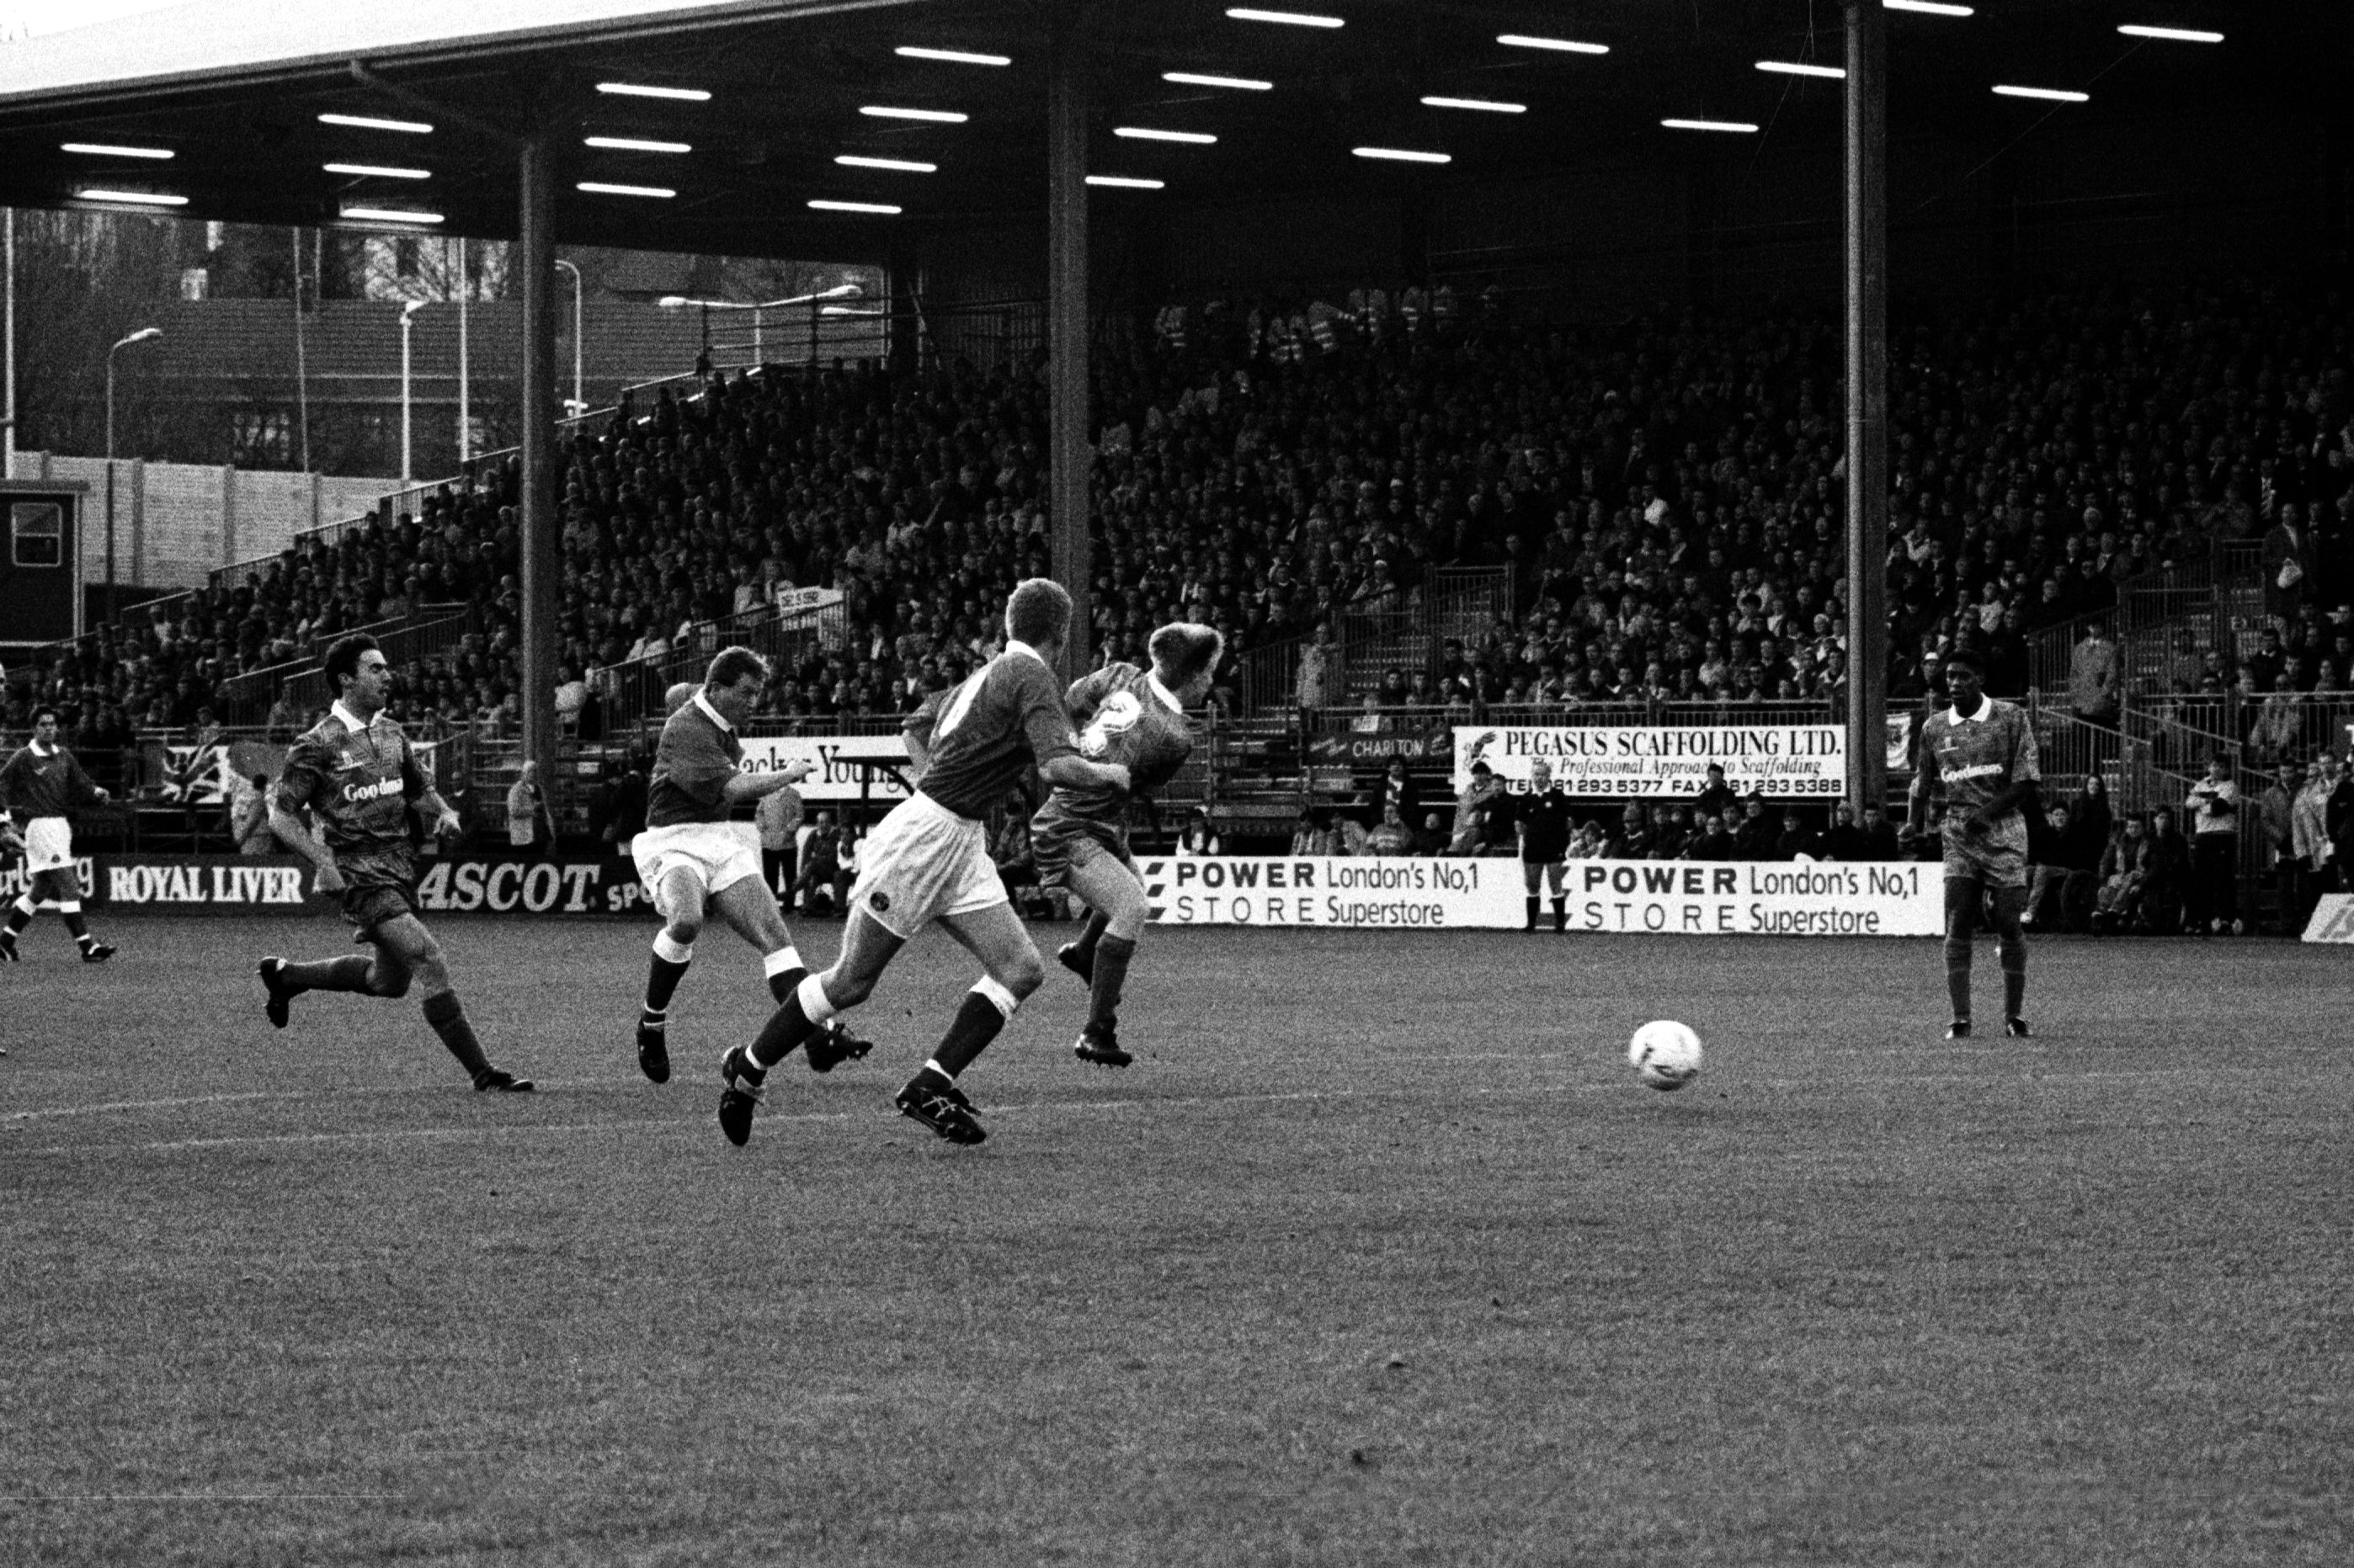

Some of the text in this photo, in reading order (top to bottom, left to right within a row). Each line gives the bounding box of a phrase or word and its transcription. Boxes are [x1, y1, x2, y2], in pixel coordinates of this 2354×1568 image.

[1505, 730, 1841, 757] PEGASUS SCAFFOLDING LTD.
[1560, 757, 1643, 777] Professional
[1650, 757, 1713, 778] Approac
[1740, 757, 1821, 778] Scaffolding
[1548, 779, 1573, 792] 81
[1578, 779, 1611, 793] 293
[1616, 779, 1664, 793] 5377
[1672, 779, 1709, 793] FAX
[1723, 779, 1750, 792] 81
[1755, 779, 1790, 793] 293
[1794, 779, 1842, 793] 5388
[109, 865, 207, 903] ROYAL
[211, 866, 304, 903] LIVER
[418, 862, 601, 912] ASCOT
[1178, 862, 1315, 888] POWER
[1327, 860, 1425, 890] London's
[1584, 866, 1737, 894] POWER
[1750, 865, 1859, 896] London's
[1178, 896, 1315, 922] STORE
[1327, 895, 1444, 926] Superstore
[1584, 902, 1737, 932] STORE
[1750, 903, 1881, 935] Superstore
